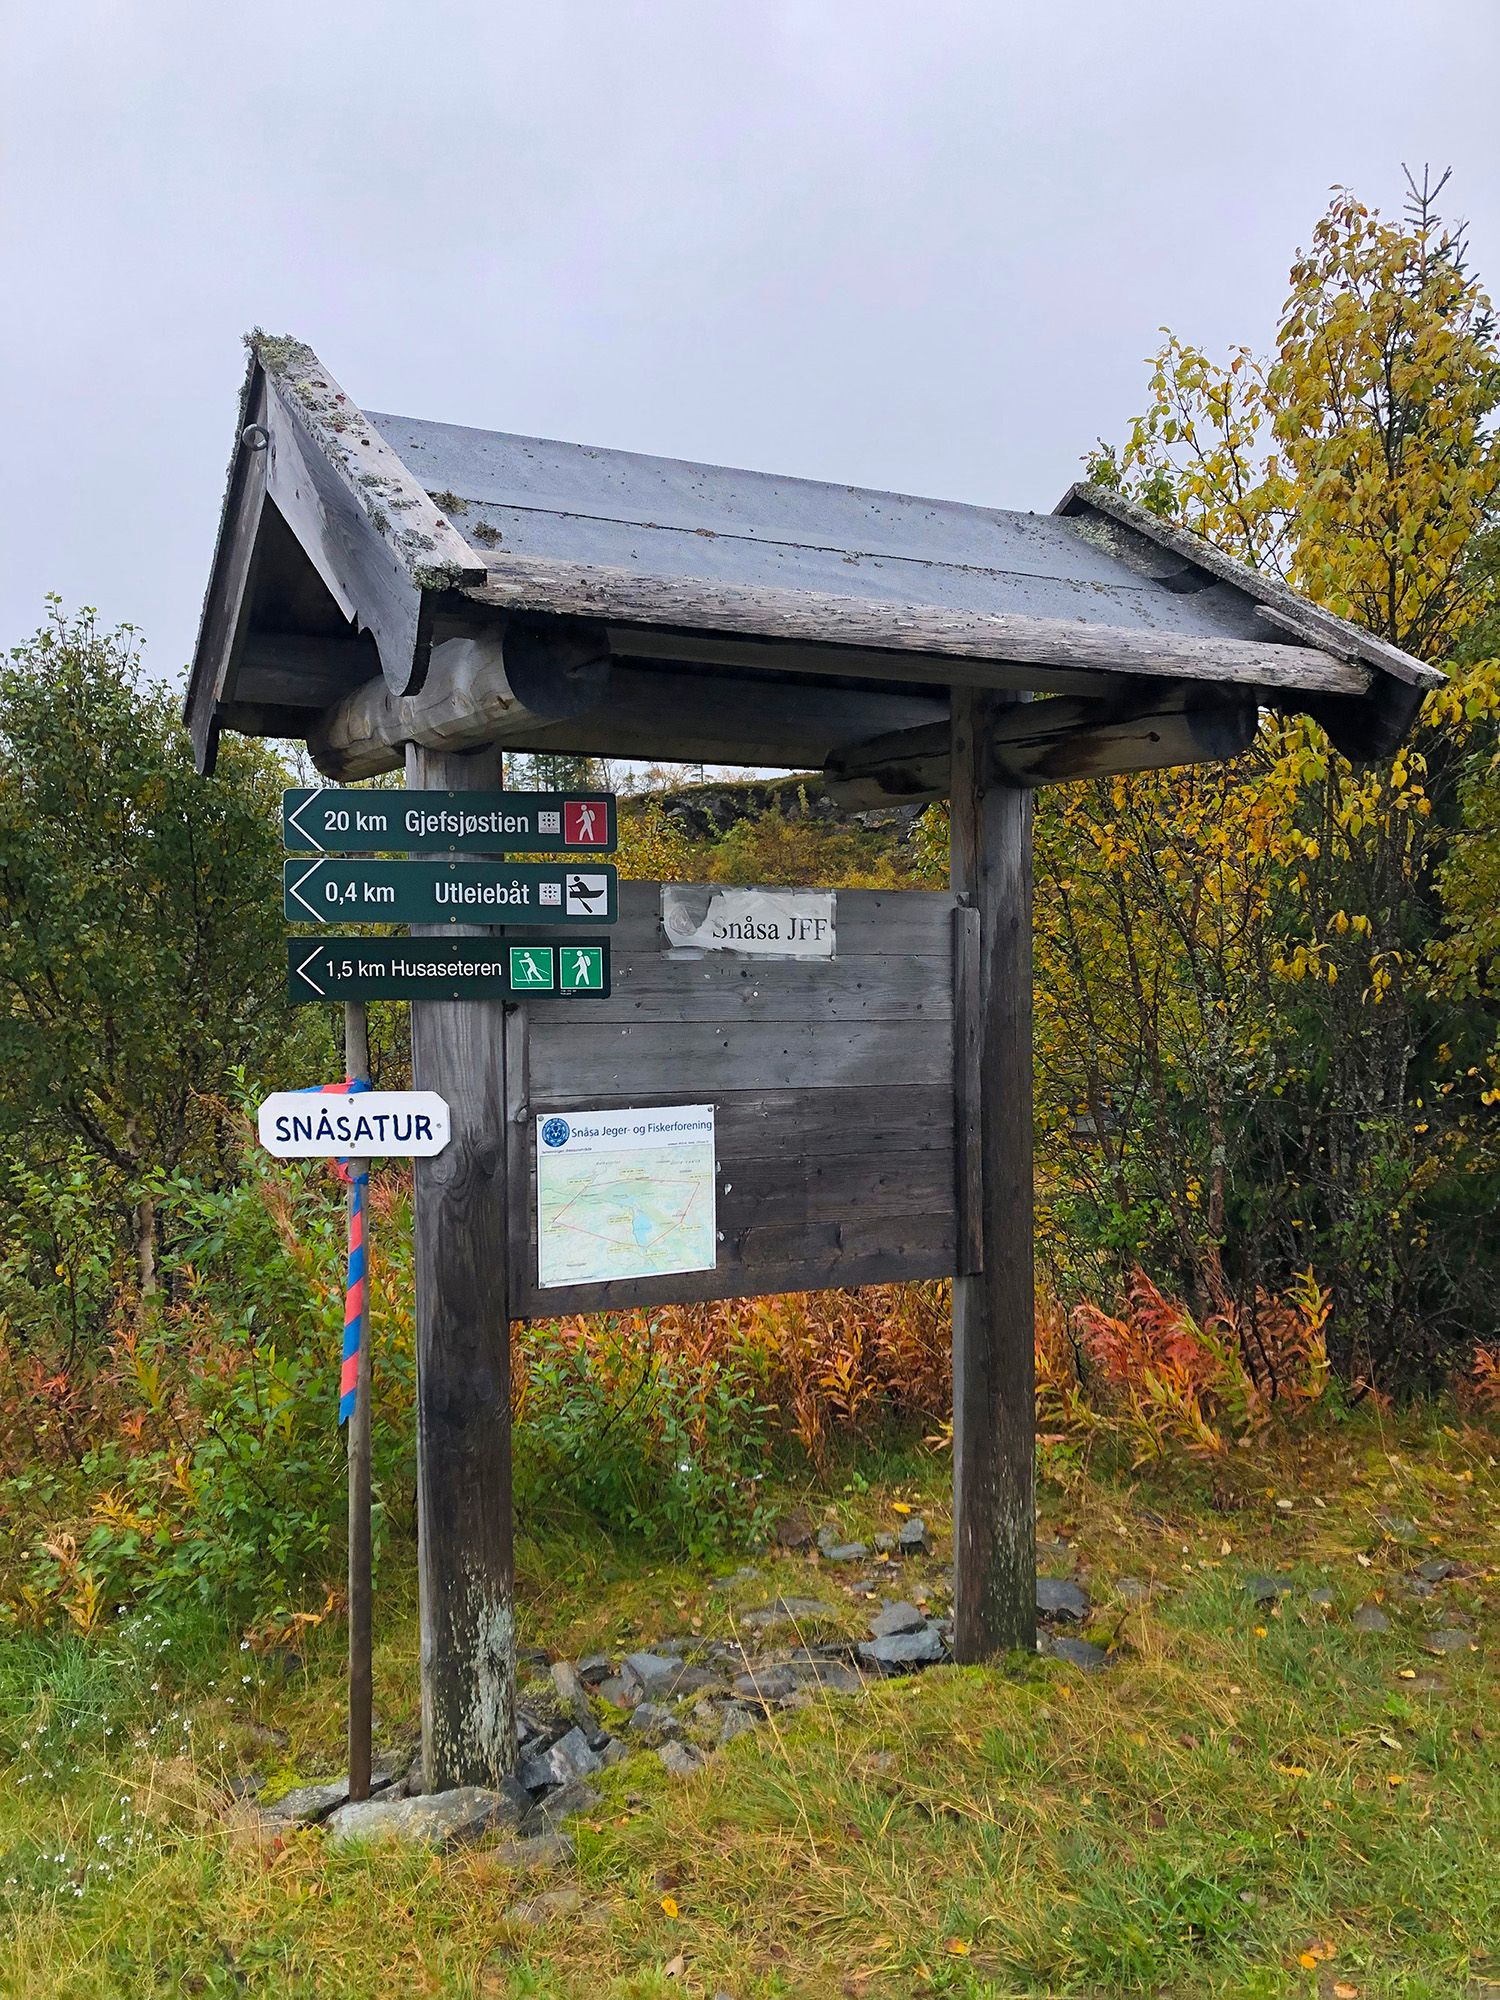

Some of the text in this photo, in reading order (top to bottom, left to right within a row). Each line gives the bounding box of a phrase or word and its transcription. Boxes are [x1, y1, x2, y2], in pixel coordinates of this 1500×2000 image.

[324, 810, 530, 837] 20 km Gjefsjøstien
[325, 880, 530, 905] 0,4 km Utleiebåt
[787, 917, 828, 941] JFF
[326, 959, 502, 979] 1,5 km Husaseteren
[275, 1107, 434, 1142] SNÅSATUR
[571, 1119, 713, 1138] Snåsa Jeger- og Fiskerforening
